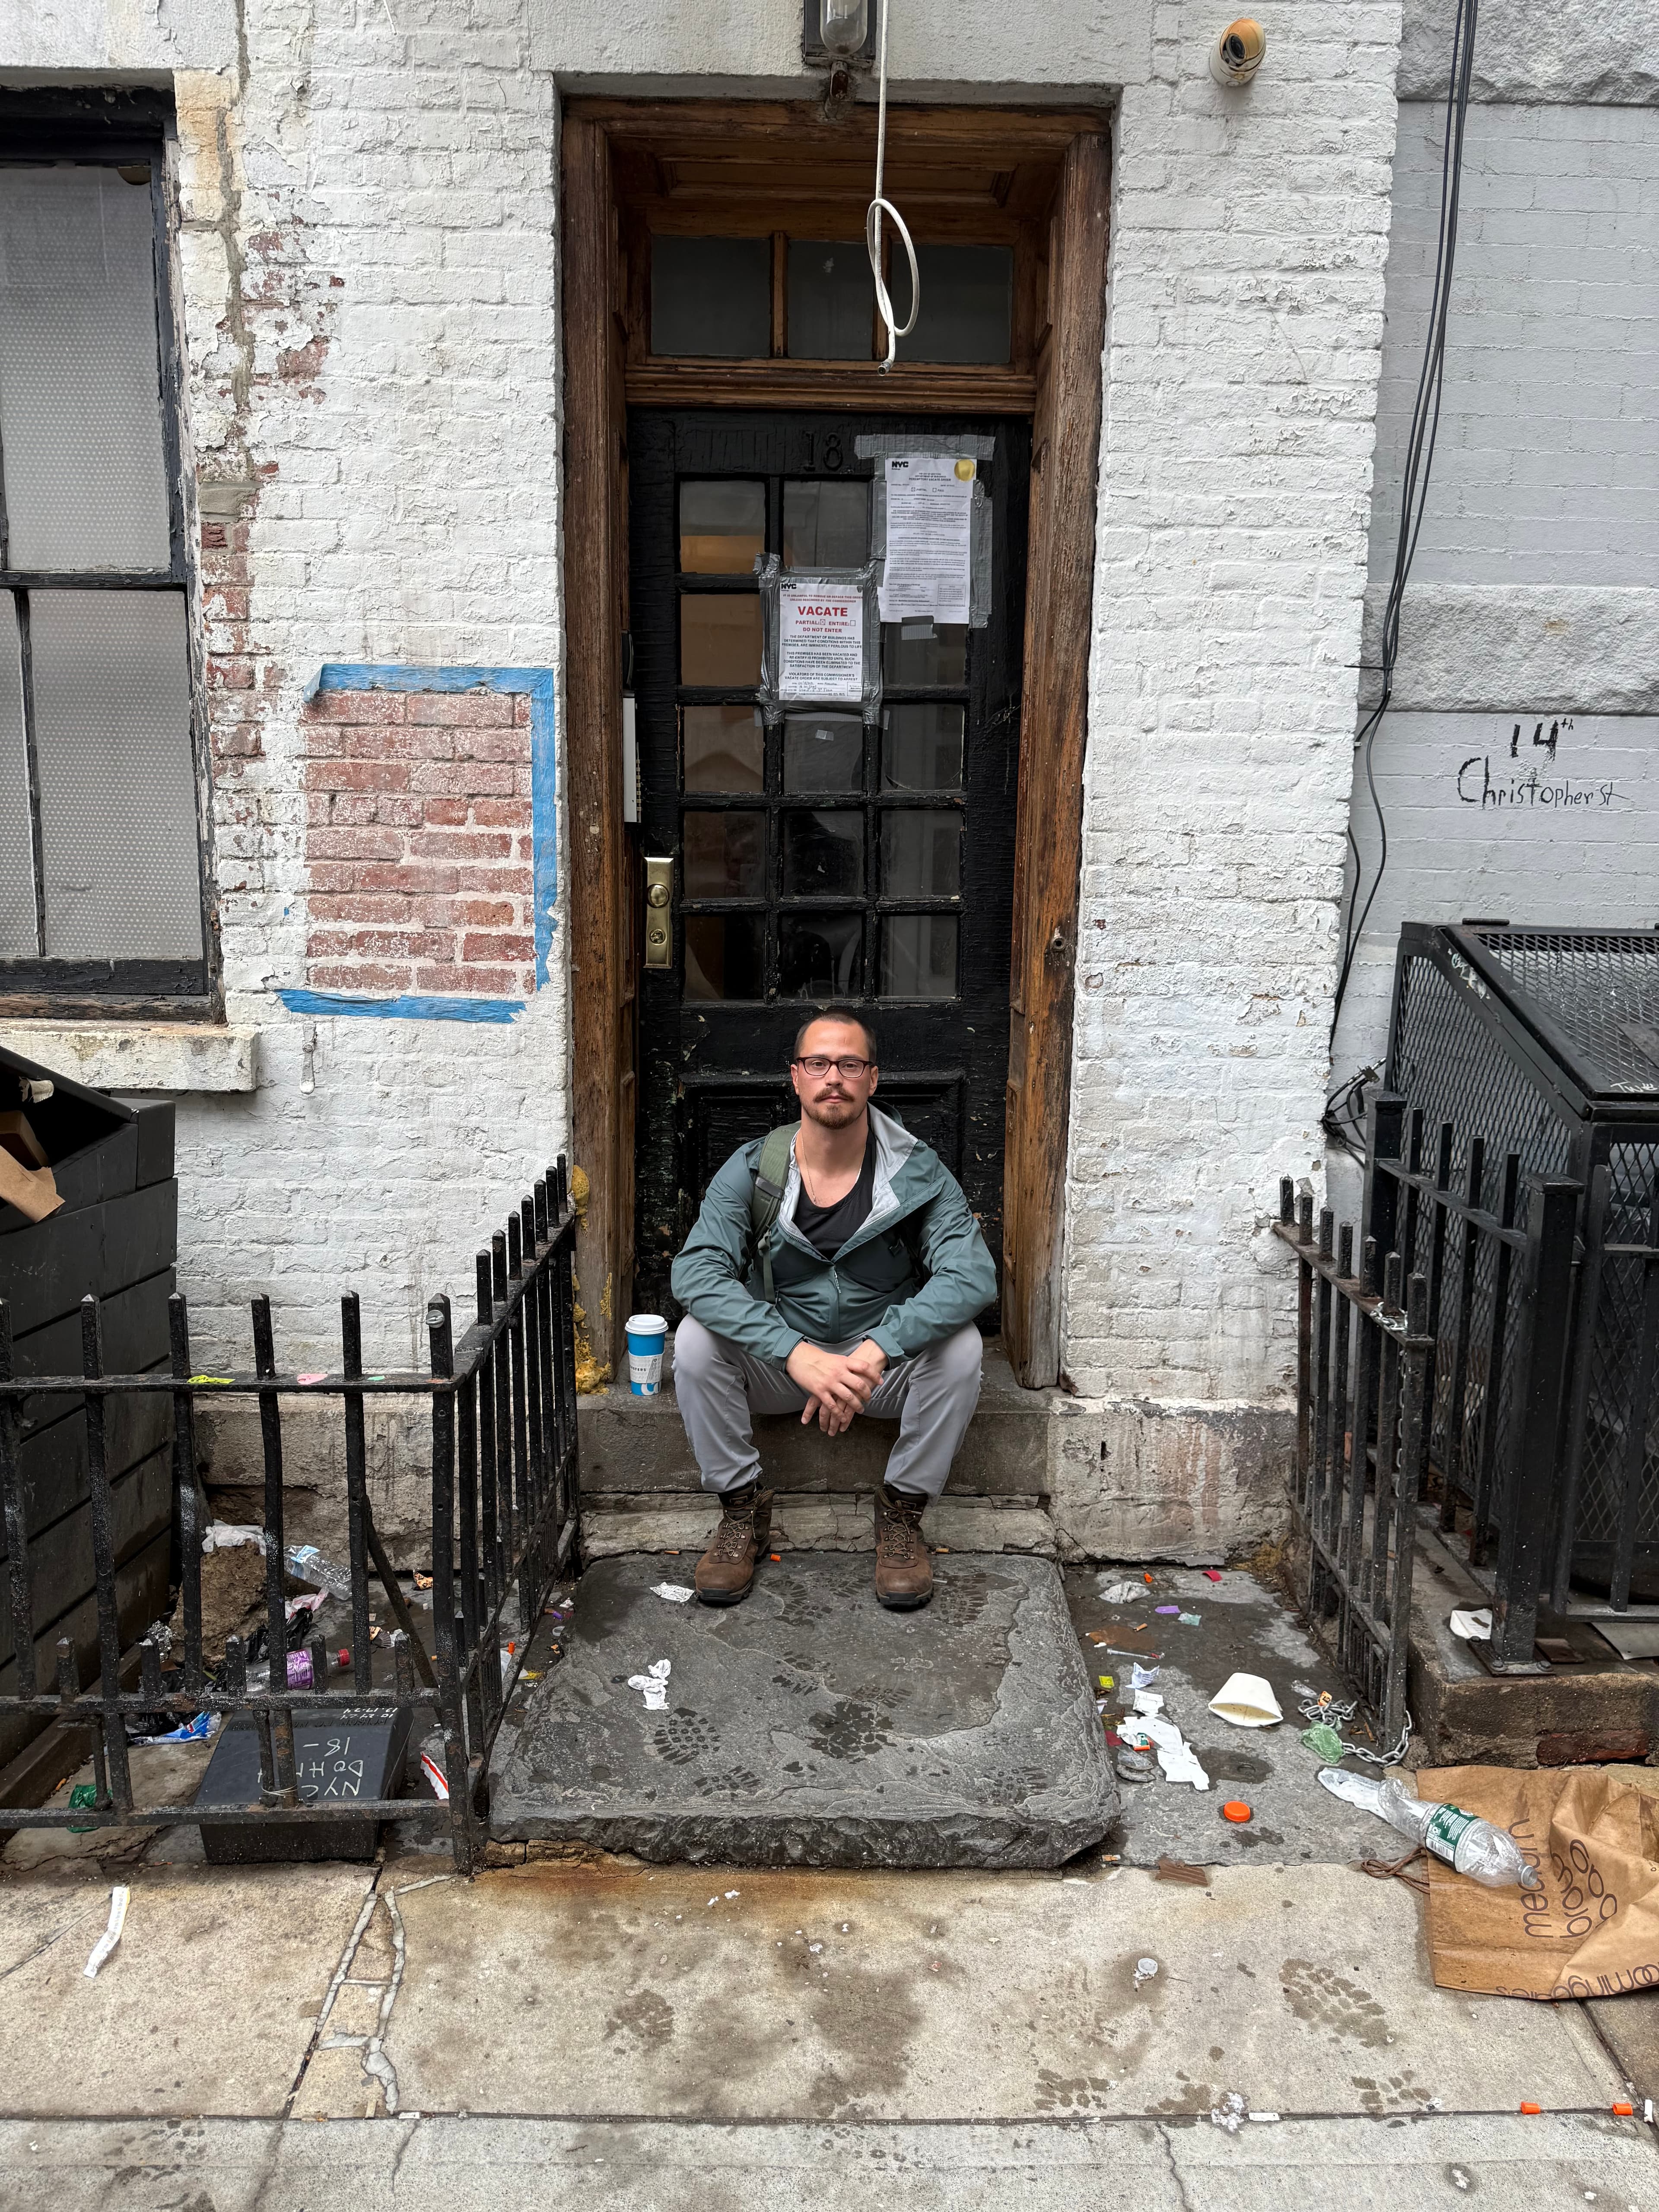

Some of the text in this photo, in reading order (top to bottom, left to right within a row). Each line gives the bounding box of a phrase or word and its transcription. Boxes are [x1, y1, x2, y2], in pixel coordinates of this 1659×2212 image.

[803, 432, 843, 471] 18
[798, 606, 848, 617] VACATE
[301, 1777, 360, 1797] NYC
[1551, 1852, 1592, 1939] brow
[1570, 1839, 1618, 1929] bag
